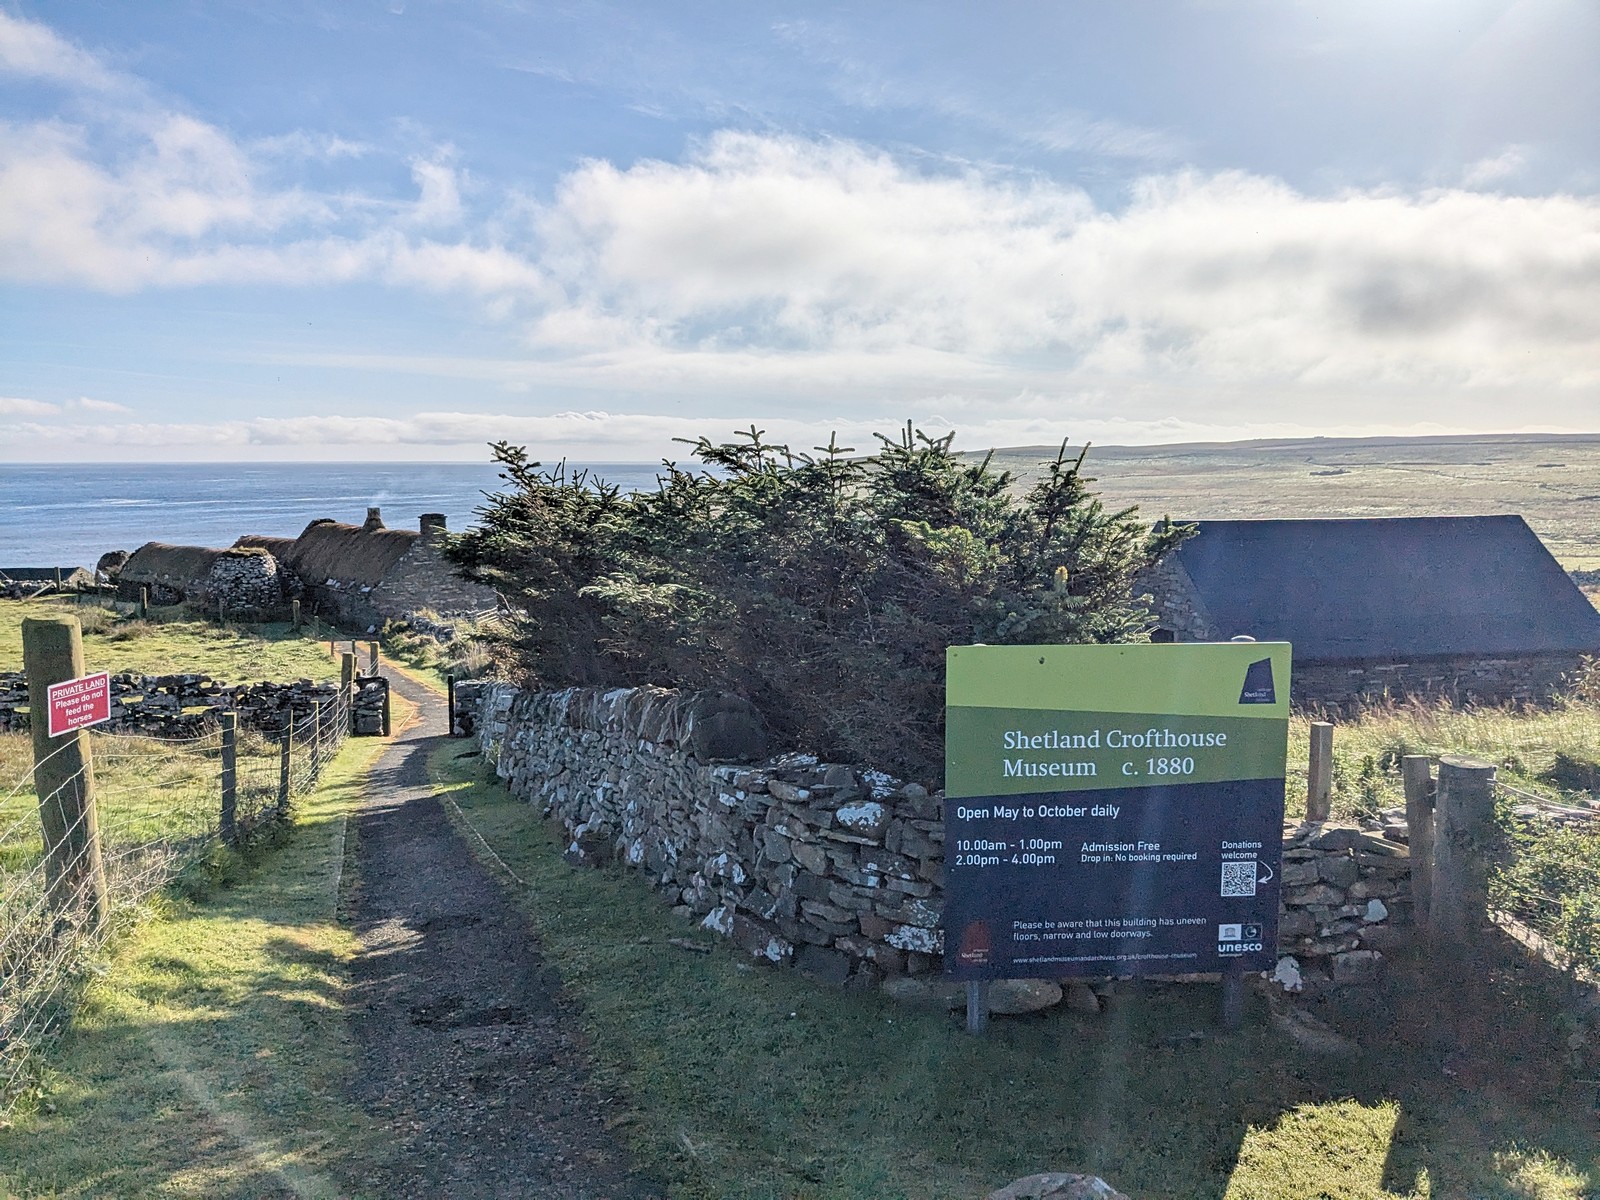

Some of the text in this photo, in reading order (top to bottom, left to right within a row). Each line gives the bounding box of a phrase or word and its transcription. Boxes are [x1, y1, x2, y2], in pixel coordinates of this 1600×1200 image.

[52, 677, 106, 699] PRIVATE LAND
[55, 689, 103, 710] Please do not
[65, 703, 94, 716] feed the
[68, 713, 93, 725] horses
[1003, 729, 1227, 749] Shetland Crofthouse
[1003, 757, 1194, 777] Museum c. 1880
[957, 804, 1120, 821] Open May to October daily
[956, 840, 1007, 851] 10.00am
[1019, 839, 1062, 852] 1.00pm
[1081, 841, 1160, 852] Admission Free
[1221, 840, 1262, 849] Donations
[956, 854, 1000, 867] 2.00pm
[1011, 853, 1055, 866] 4.00pm
[1081, 852, 1198, 863] Drop in: No booking required
[1221, 851, 1258, 859] welcome
[1013, 920, 1043, 929] Please
[1044, 920, 1055, 929] be
[1085, 919, 1103, 928] that
[1104, 918, 1120, 927] this
[1122, 918, 1157, 928] building
[1159, 917, 1175, 926] has
[1176, 917, 1207, 925] uneven
[1013, 932, 1041, 941] floors,
[1075, 931, 1091, 939] and
[1093, 931, 1108, 939] low
[1110, 930, 1153, 939] doorways.
[1218, 943, 1263, 952] unesco
